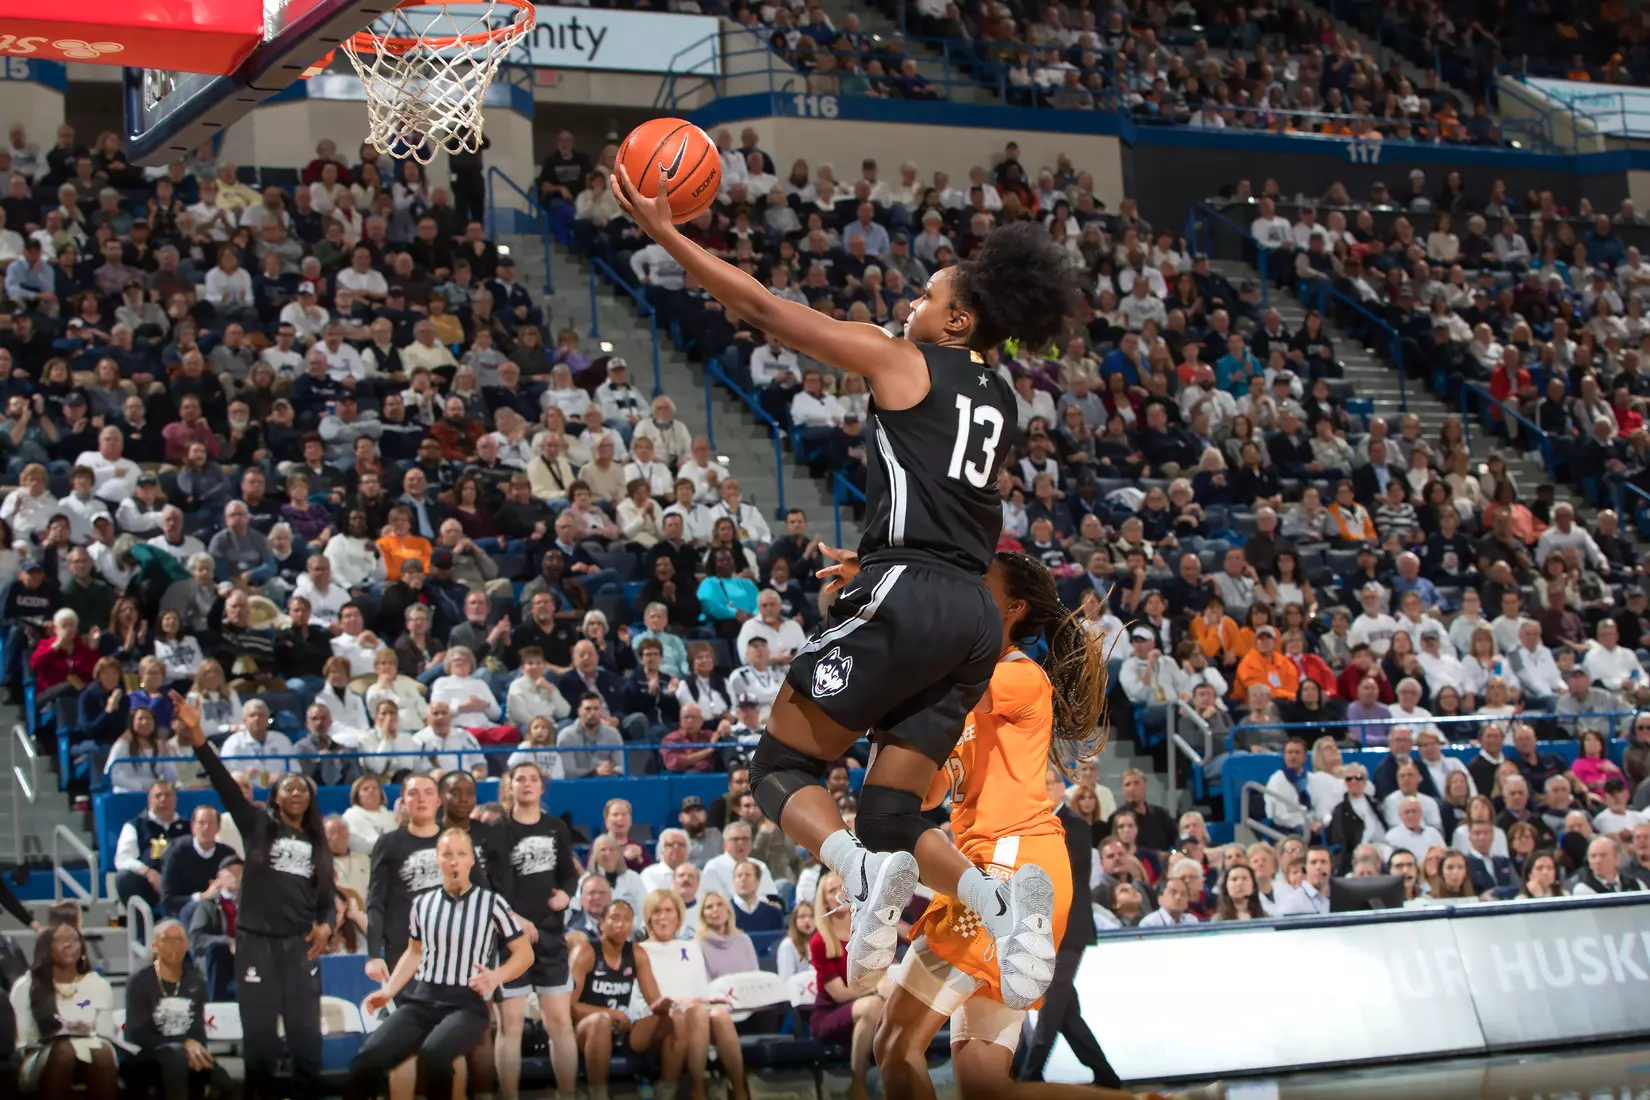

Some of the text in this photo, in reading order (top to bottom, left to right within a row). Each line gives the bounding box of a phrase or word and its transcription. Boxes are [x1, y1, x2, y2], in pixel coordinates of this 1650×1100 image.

[793, 94, 839, 118] 116
[1346, 143, 1382, 164] 117
[691, 168, 717, 198] UCONN
[947, 393, 1005, 488] 13
[592, 979, 631, 996] UCONN
